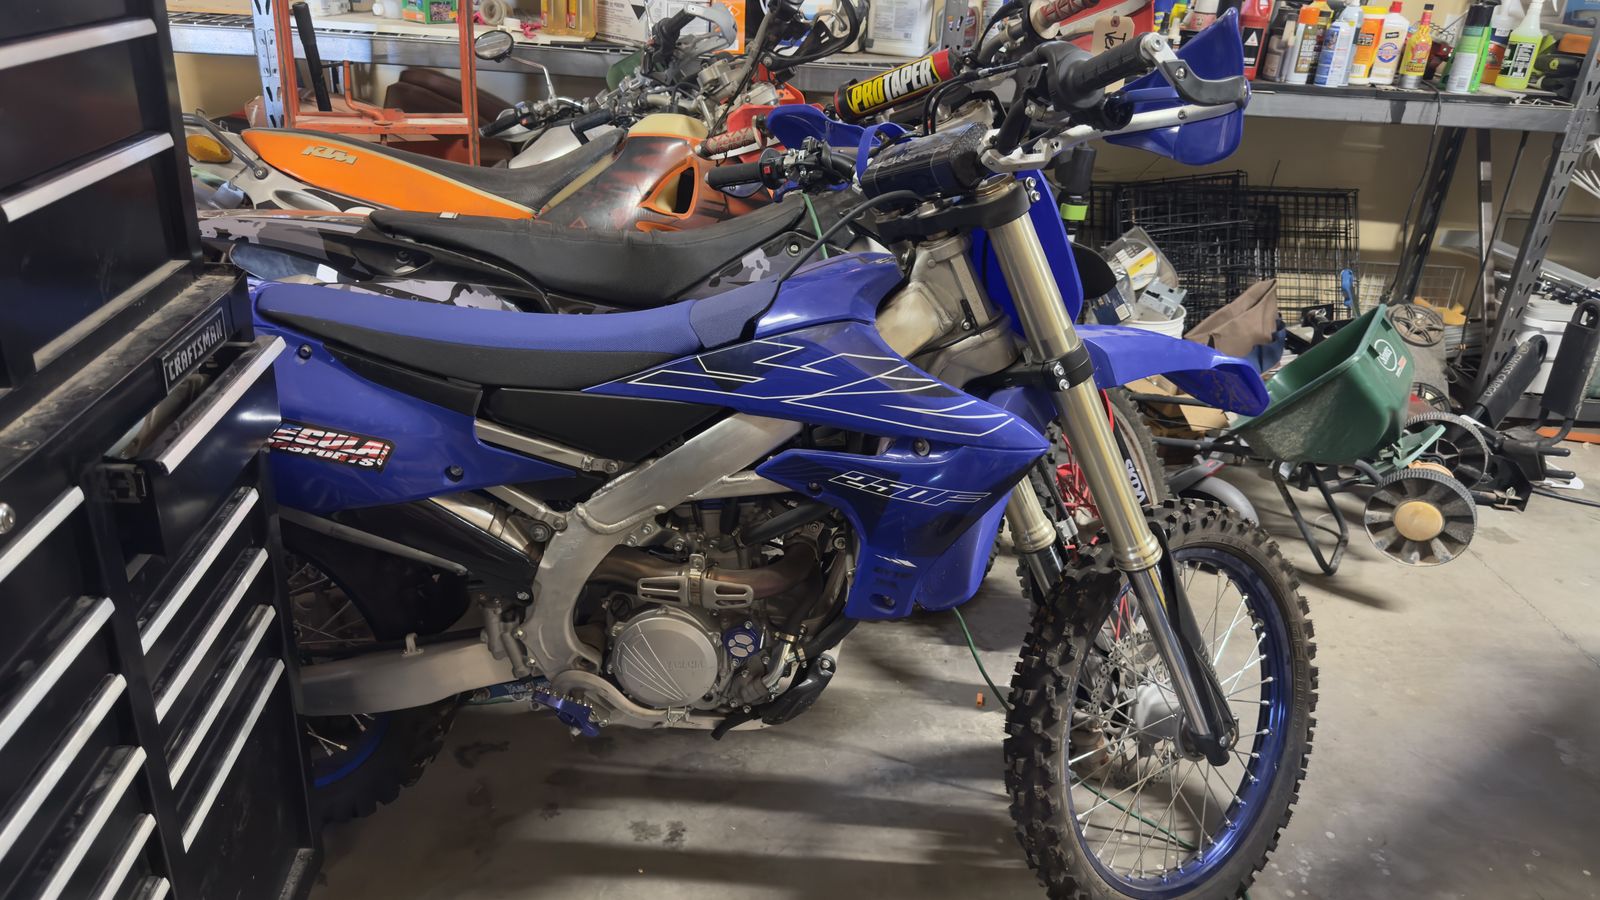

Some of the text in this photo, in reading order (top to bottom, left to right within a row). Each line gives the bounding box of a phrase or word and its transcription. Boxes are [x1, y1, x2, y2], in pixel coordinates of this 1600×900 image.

[850, 58, 933, 113] PROTAPER
[302, 145, 358, 165] KTM
[167, 319, 224, 381] CRAFTSMAN
[273, 423, 386, 459] ECULA
